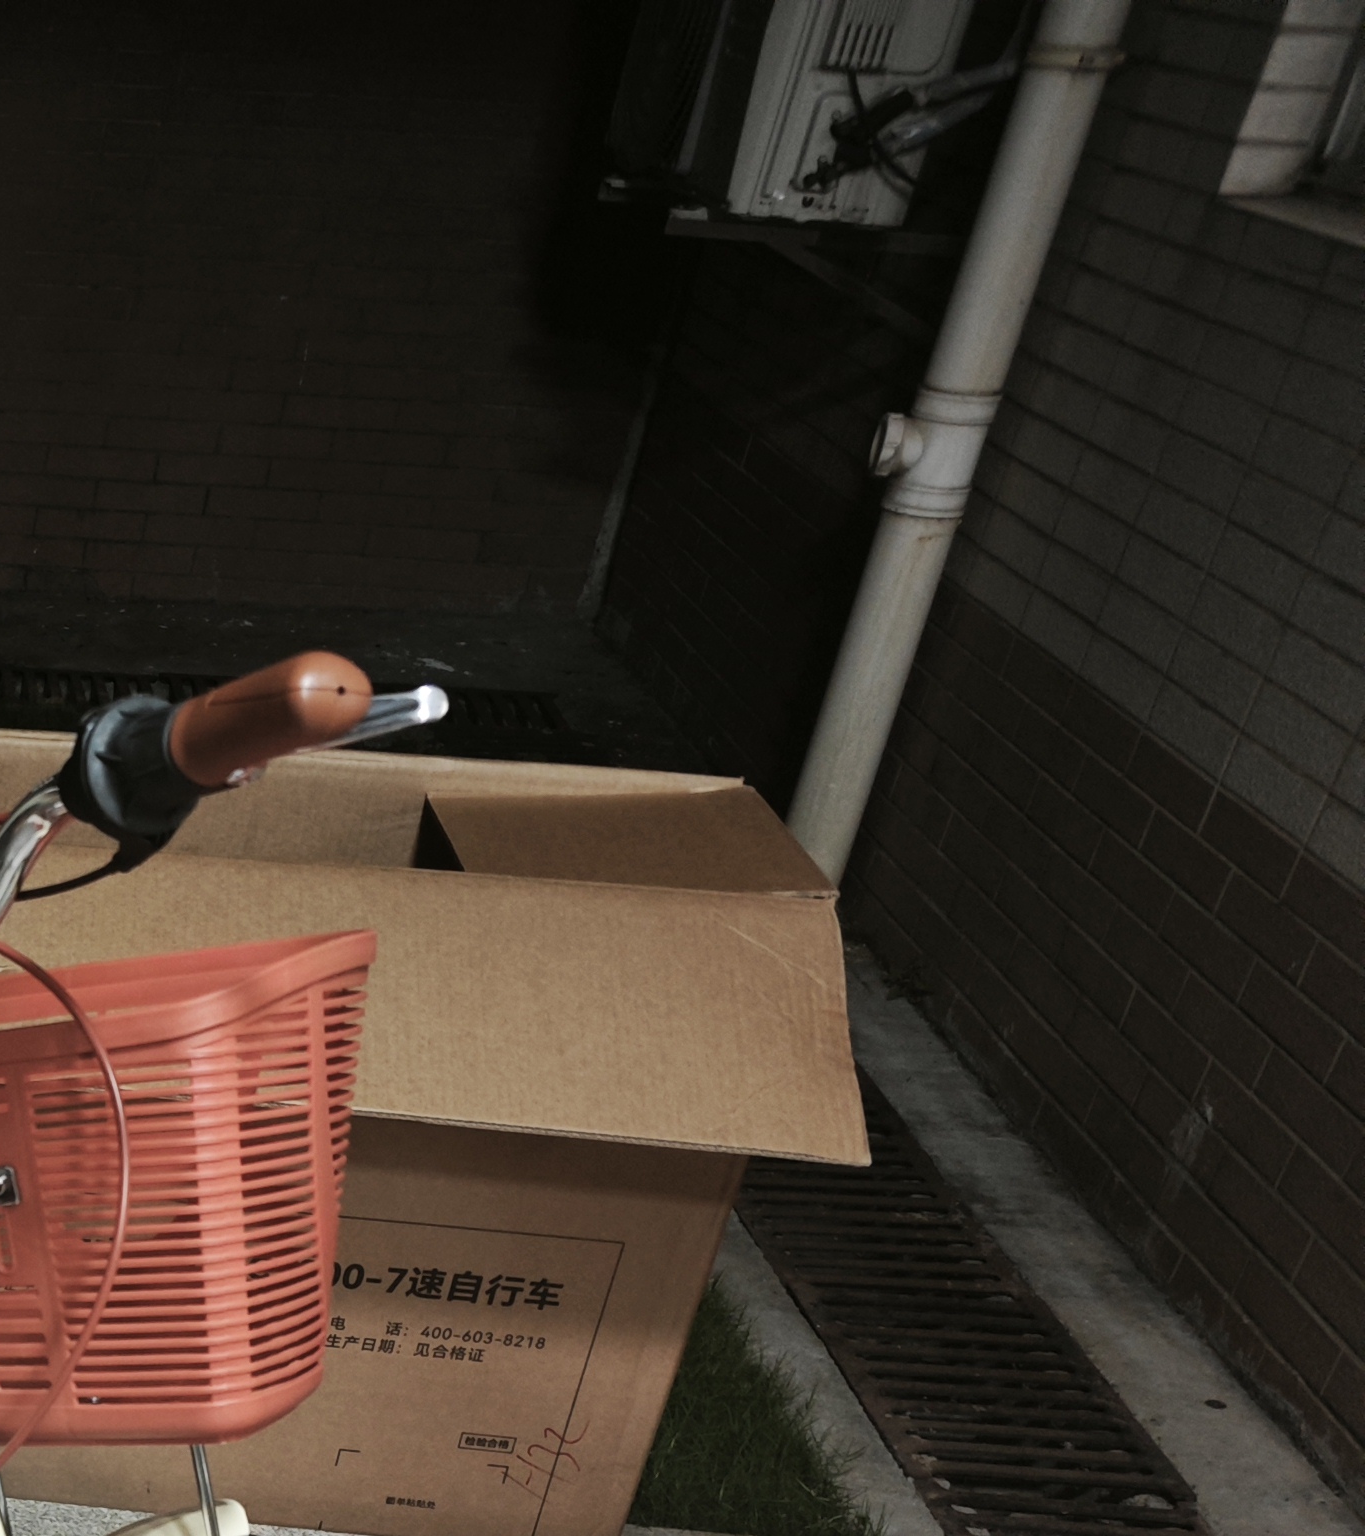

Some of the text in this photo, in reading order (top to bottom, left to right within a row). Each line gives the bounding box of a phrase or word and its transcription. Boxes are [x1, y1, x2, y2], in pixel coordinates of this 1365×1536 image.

[325, 1334, 485, 1364] 生产日期： 见合格证
[420, 1324, 547, 1351] 400-603-8218
